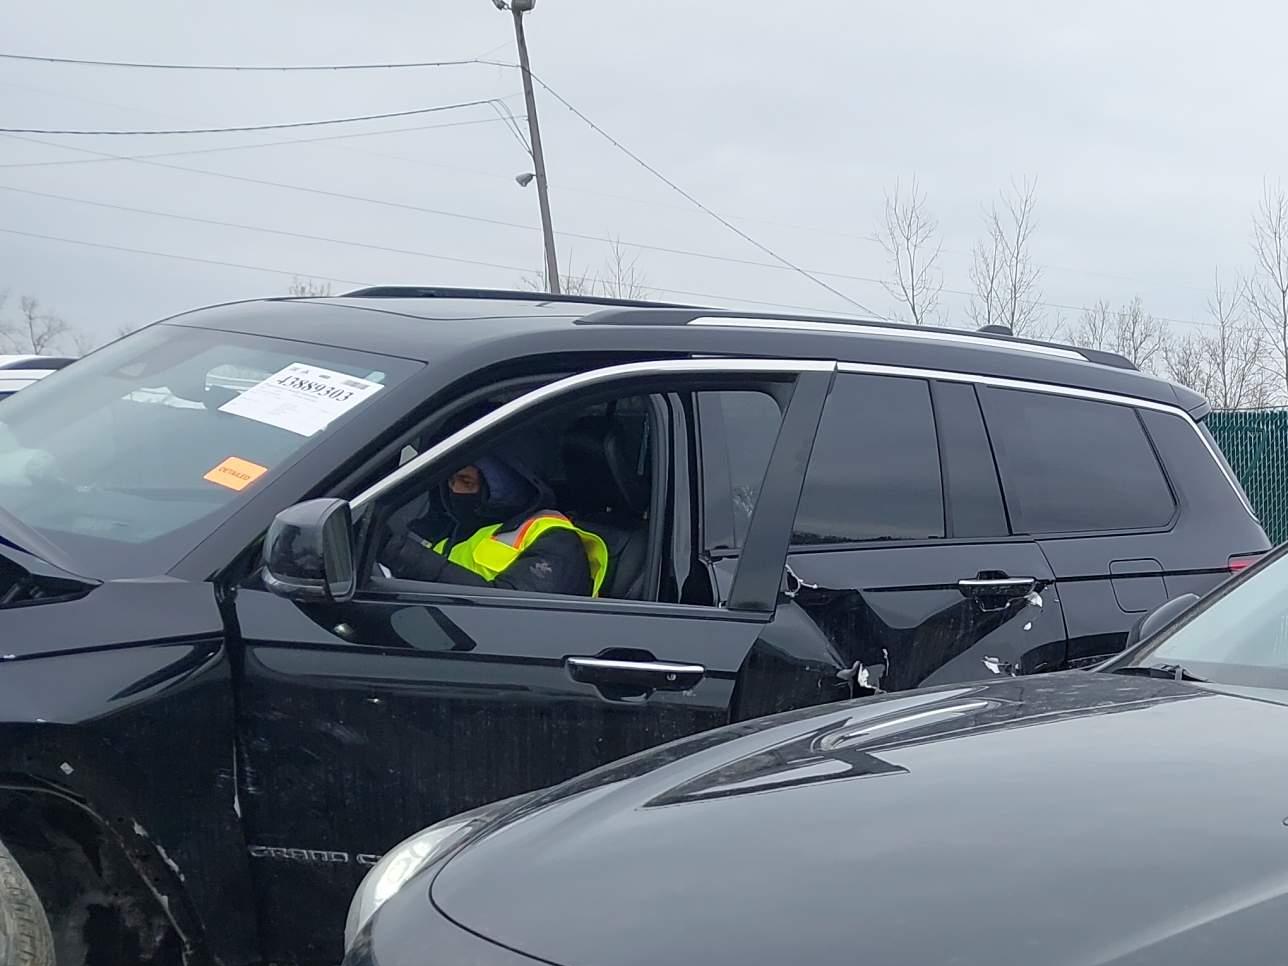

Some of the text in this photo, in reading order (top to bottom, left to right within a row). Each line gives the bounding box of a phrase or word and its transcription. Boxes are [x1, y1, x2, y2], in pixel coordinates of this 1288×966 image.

[277, 376, 353, 401] 43889303
[249, 845, 382, 864] GRAND C
